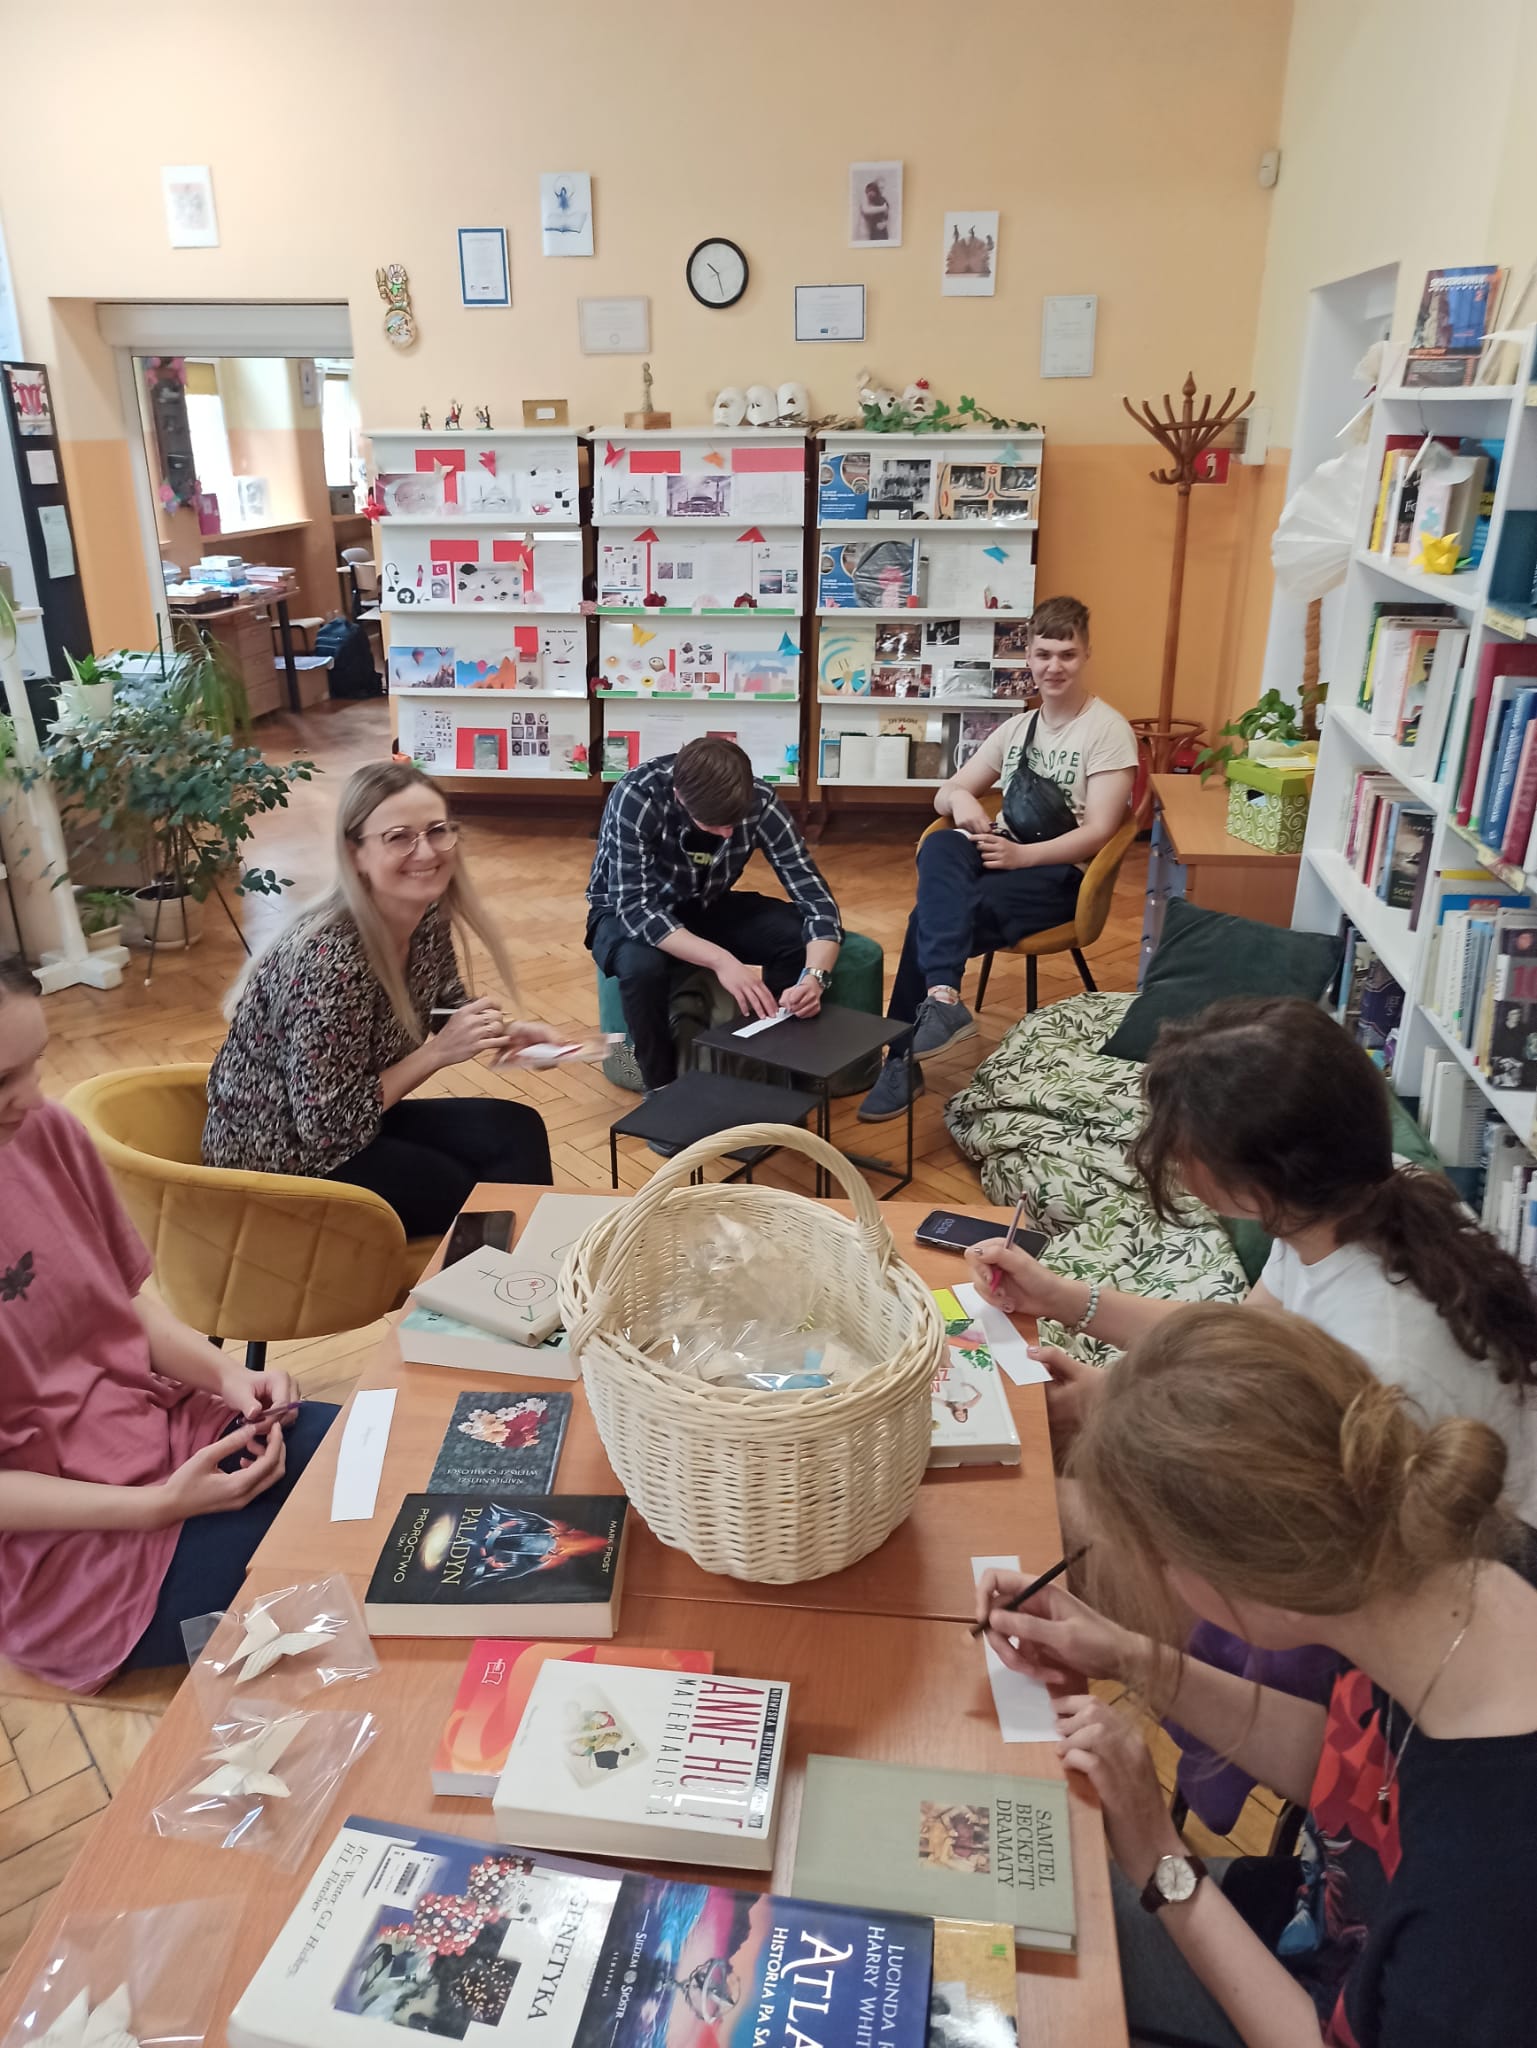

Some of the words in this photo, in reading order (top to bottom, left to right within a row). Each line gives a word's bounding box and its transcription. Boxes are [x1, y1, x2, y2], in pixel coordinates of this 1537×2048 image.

[393, 1507, 430, 1583] PROROCTWO
[440, 1507, 483, 1585] PALADYN
[600, 1546, 616, 1575] FROST
[605, 1520, 618, 1544] MARK
[687, 1680, 765, 1750] ANNE
[765, 1688, 782, 1727] NORWESKA
[645, 1678, 697, 1815] MATERIALISTA
[673, 1755, 753, 1829] HOLT
[996, 1799, 1014, 1889] DRAMATY
[1016, 1803, 1035, 1890] BECKETT
[1036, 1809, 1055, 1887] SAMUEL
[527, 1893, 588, 2020] GENETYKA
[628, 1932, 648, 1968] SIEDEM
[761, 1927, 789, 1999] HISTORIA
[863, 1926, 886, 1988] HARRY
[757, 2004, 775, 2023] PA
[780, 1930, 853, 2048] ATLA
[855, 1997, 878, 2048] WHIT
[881, 1944, 905, 2031] LUCINDA
[752, 2027, 771, 2048] SA
